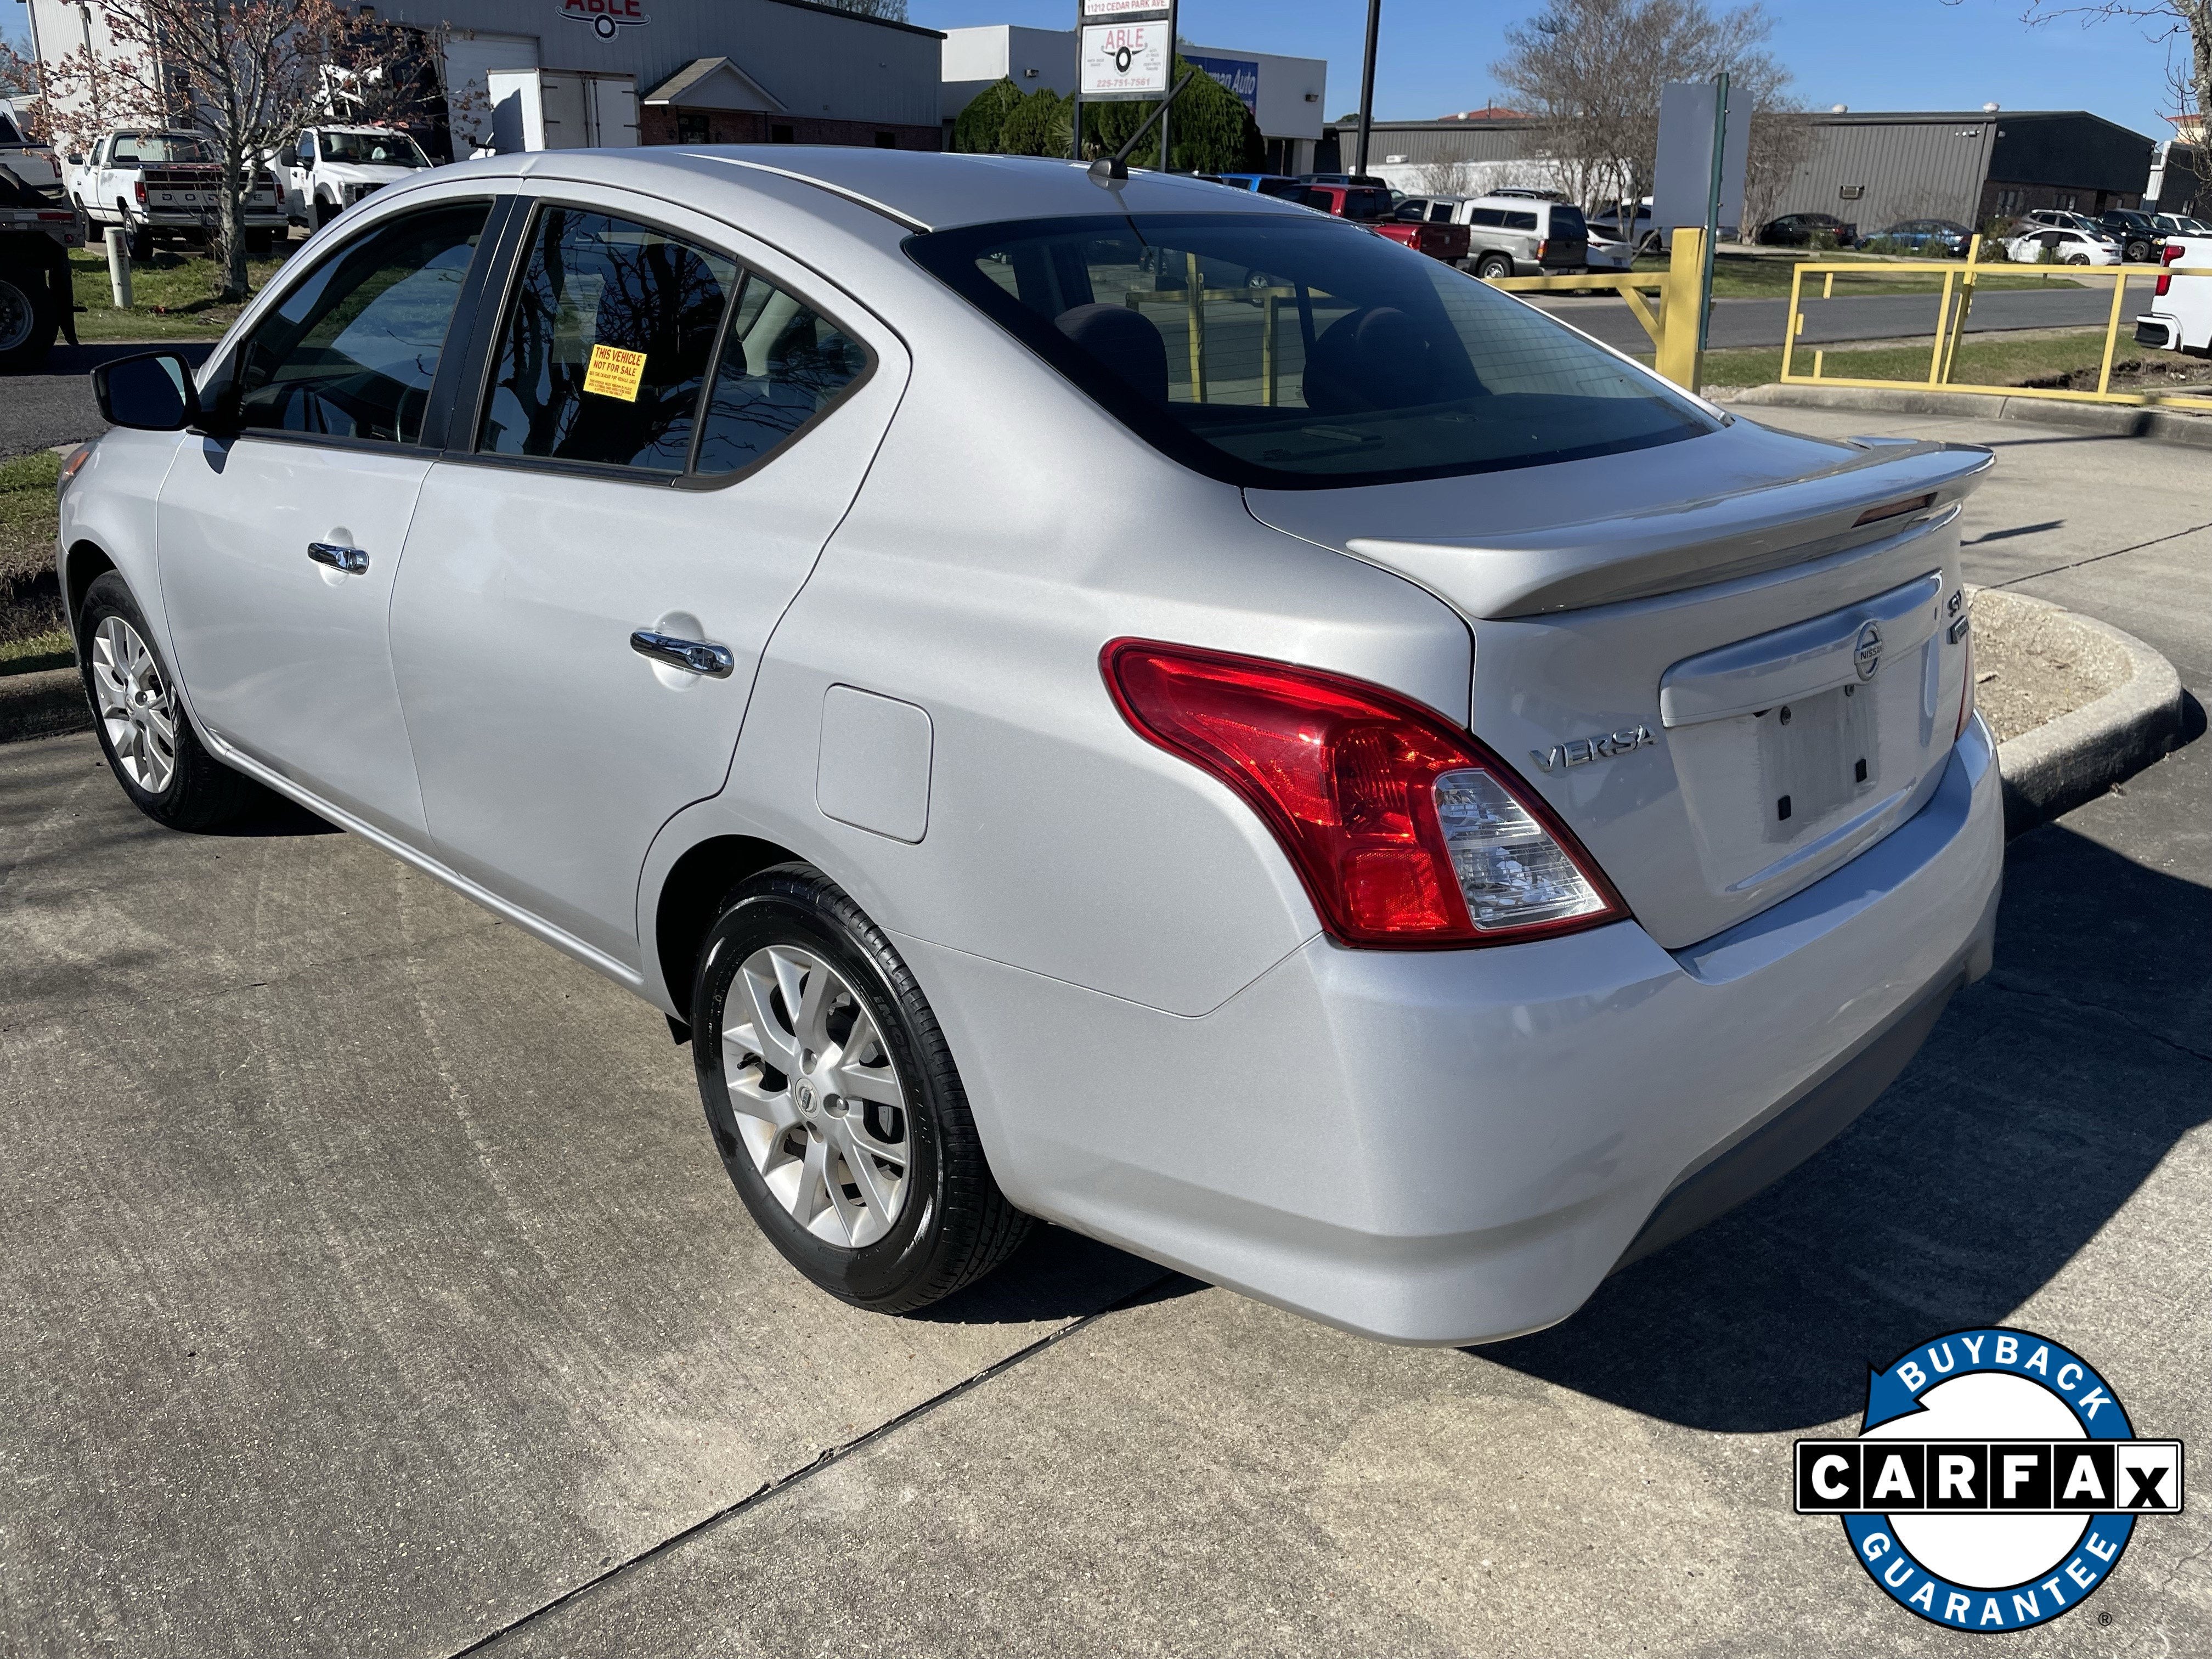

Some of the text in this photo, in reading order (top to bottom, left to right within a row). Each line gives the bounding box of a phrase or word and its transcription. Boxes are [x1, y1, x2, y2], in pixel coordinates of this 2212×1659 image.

[1087, 3, 1105, 13] 11212
[1107, 2, 1130, 11] CEDAR
[1131, 0, 1150, 9] PARK
[1105, 28, 1144, 49] ABLE
[1097, 78, 1151, 88] 225-751-7561
[1232, 69, 1256, 95] Auto
[161, 193, 263, 201] DODE
[595, 346, 642, 366] THIS VEHICLE
[593, 360, 637, 377] NOT FOR SALE
[1860, 645, 1883, 661] NISSAN
[1528, 723, 1658, 773] VERSA
